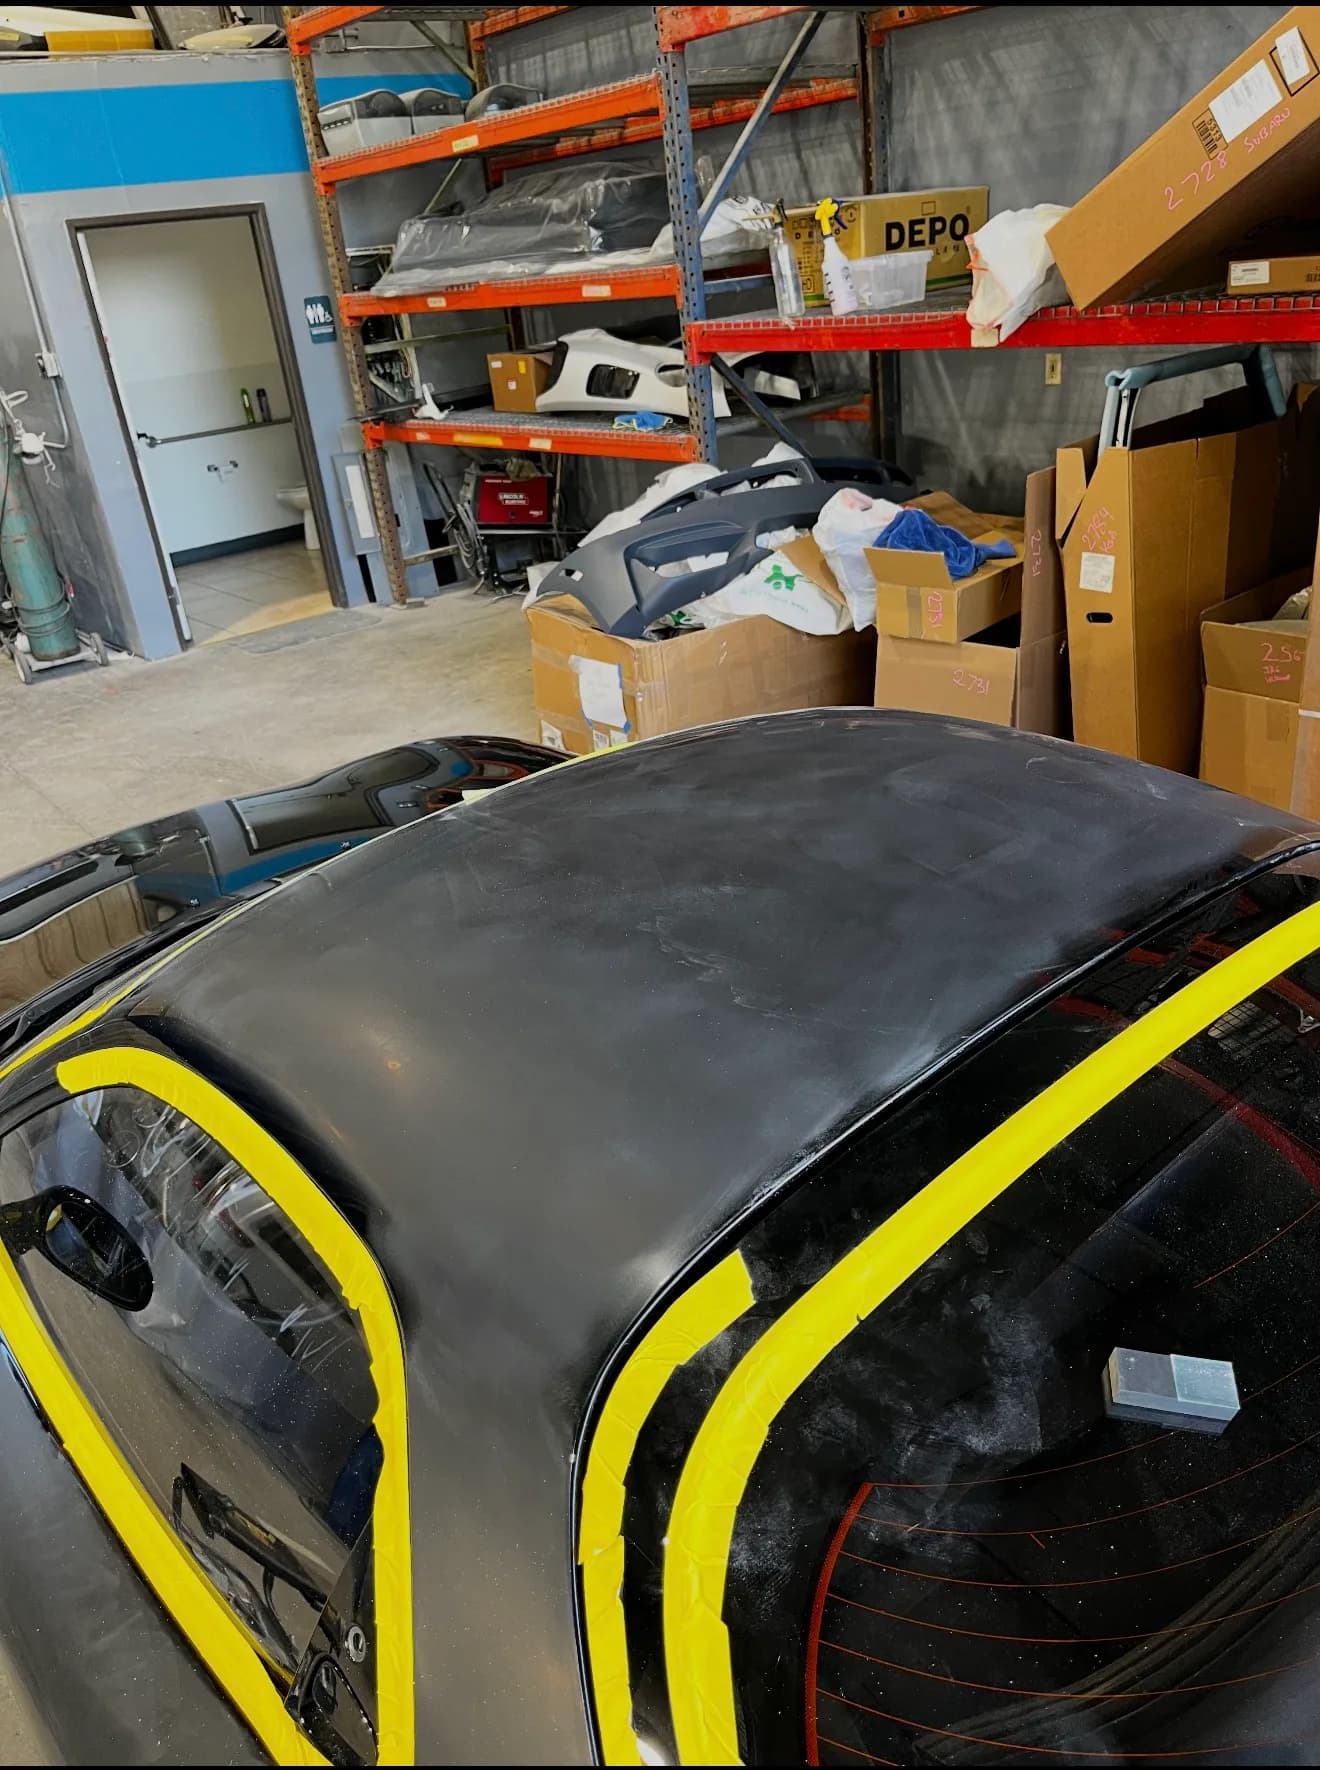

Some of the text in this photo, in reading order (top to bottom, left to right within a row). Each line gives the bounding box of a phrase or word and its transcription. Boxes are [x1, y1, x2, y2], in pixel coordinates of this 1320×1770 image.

[1164, 150, 1228, 211] 2728
[885, 212, 969, 251] DEPO
[927, 591, 944, 629] 2731
[952, 668, 990, 696] 2731
